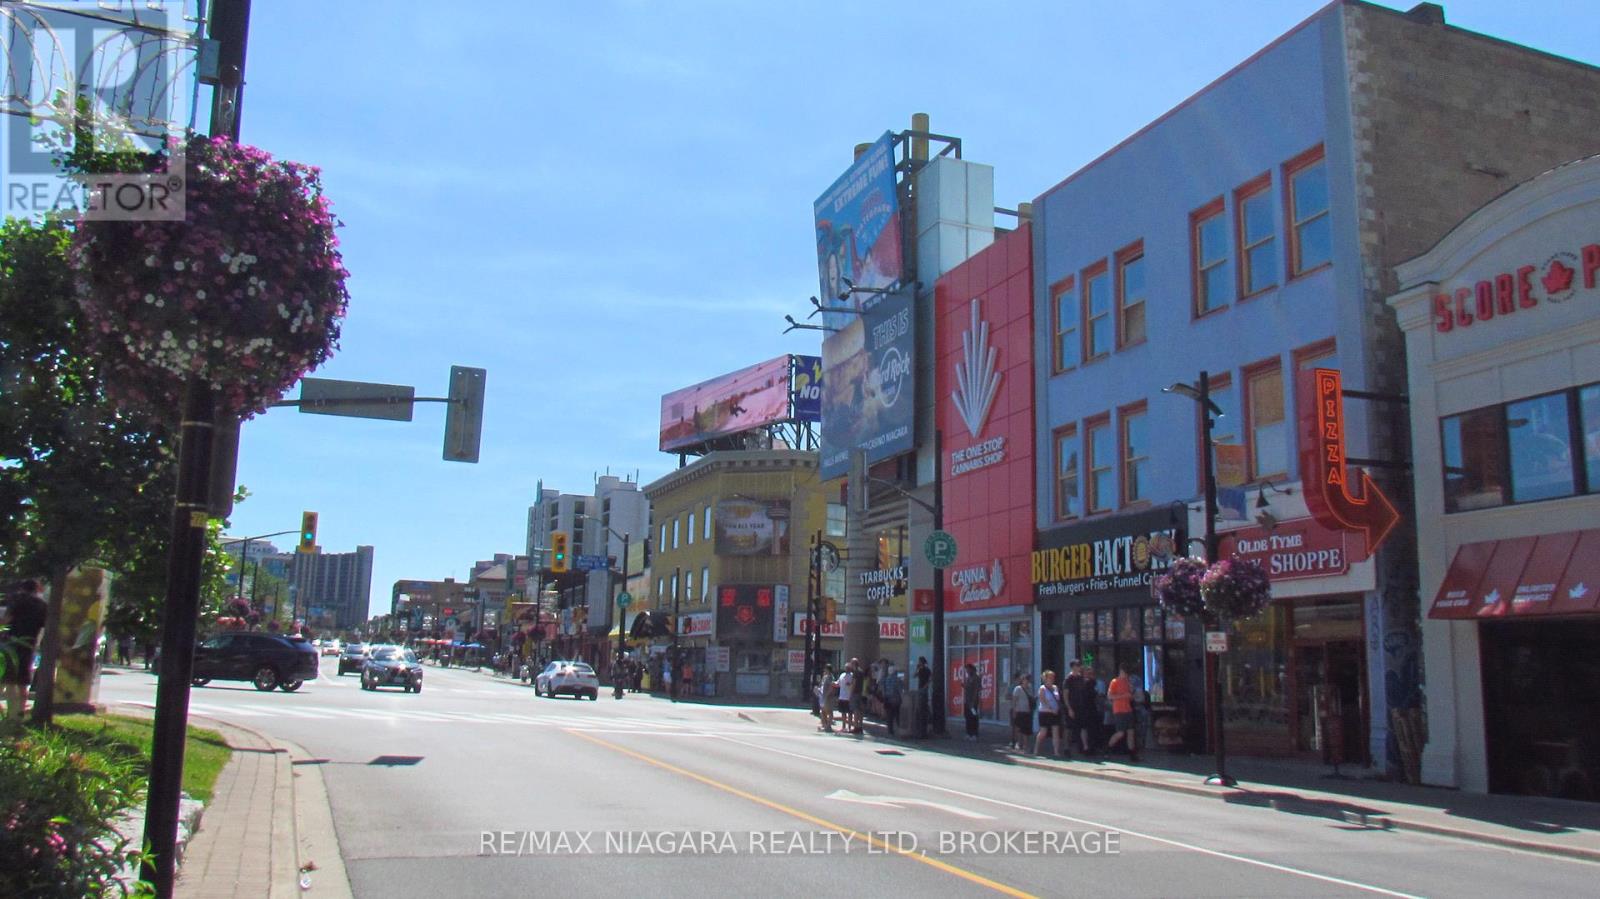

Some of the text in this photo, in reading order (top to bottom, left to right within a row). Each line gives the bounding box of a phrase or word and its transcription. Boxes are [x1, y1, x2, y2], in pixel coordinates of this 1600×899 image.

[834, 173, 868, 213] EXTREME
[1434, 265, 1538, 333] SCORE
[873, 308, 909, 350] THIS IS
[891, 351, 911, 382] Rock
[886, 425, 909, 442] NIAGARA
[1323, 378, 1341, 484] PIZZA
[951, 436, 1004, 465] THE ONE STOP
[951, 451, 1004, 476] CANNABIS SHOP
[934, 540, 948, 555] P
[1032, 543, 1092, 584] BURGER
[1270, 548, 1340, 575] SHOPPE
[860, 566, 904, 585] STARBUCKS
[951, 566, 986, 587] CANNA
[1039, 582, 1057, 596] Fresh
[1057, 581, 1085, 596] Burgers
[1090, 578, 1108, 591] Fries
[1113, 573, 1141, 588] Funnel
[867, 583, 895, 600] COFFEE
[800, 619, 848, 635] CBA
[953, 659, 990, 682] LOST
